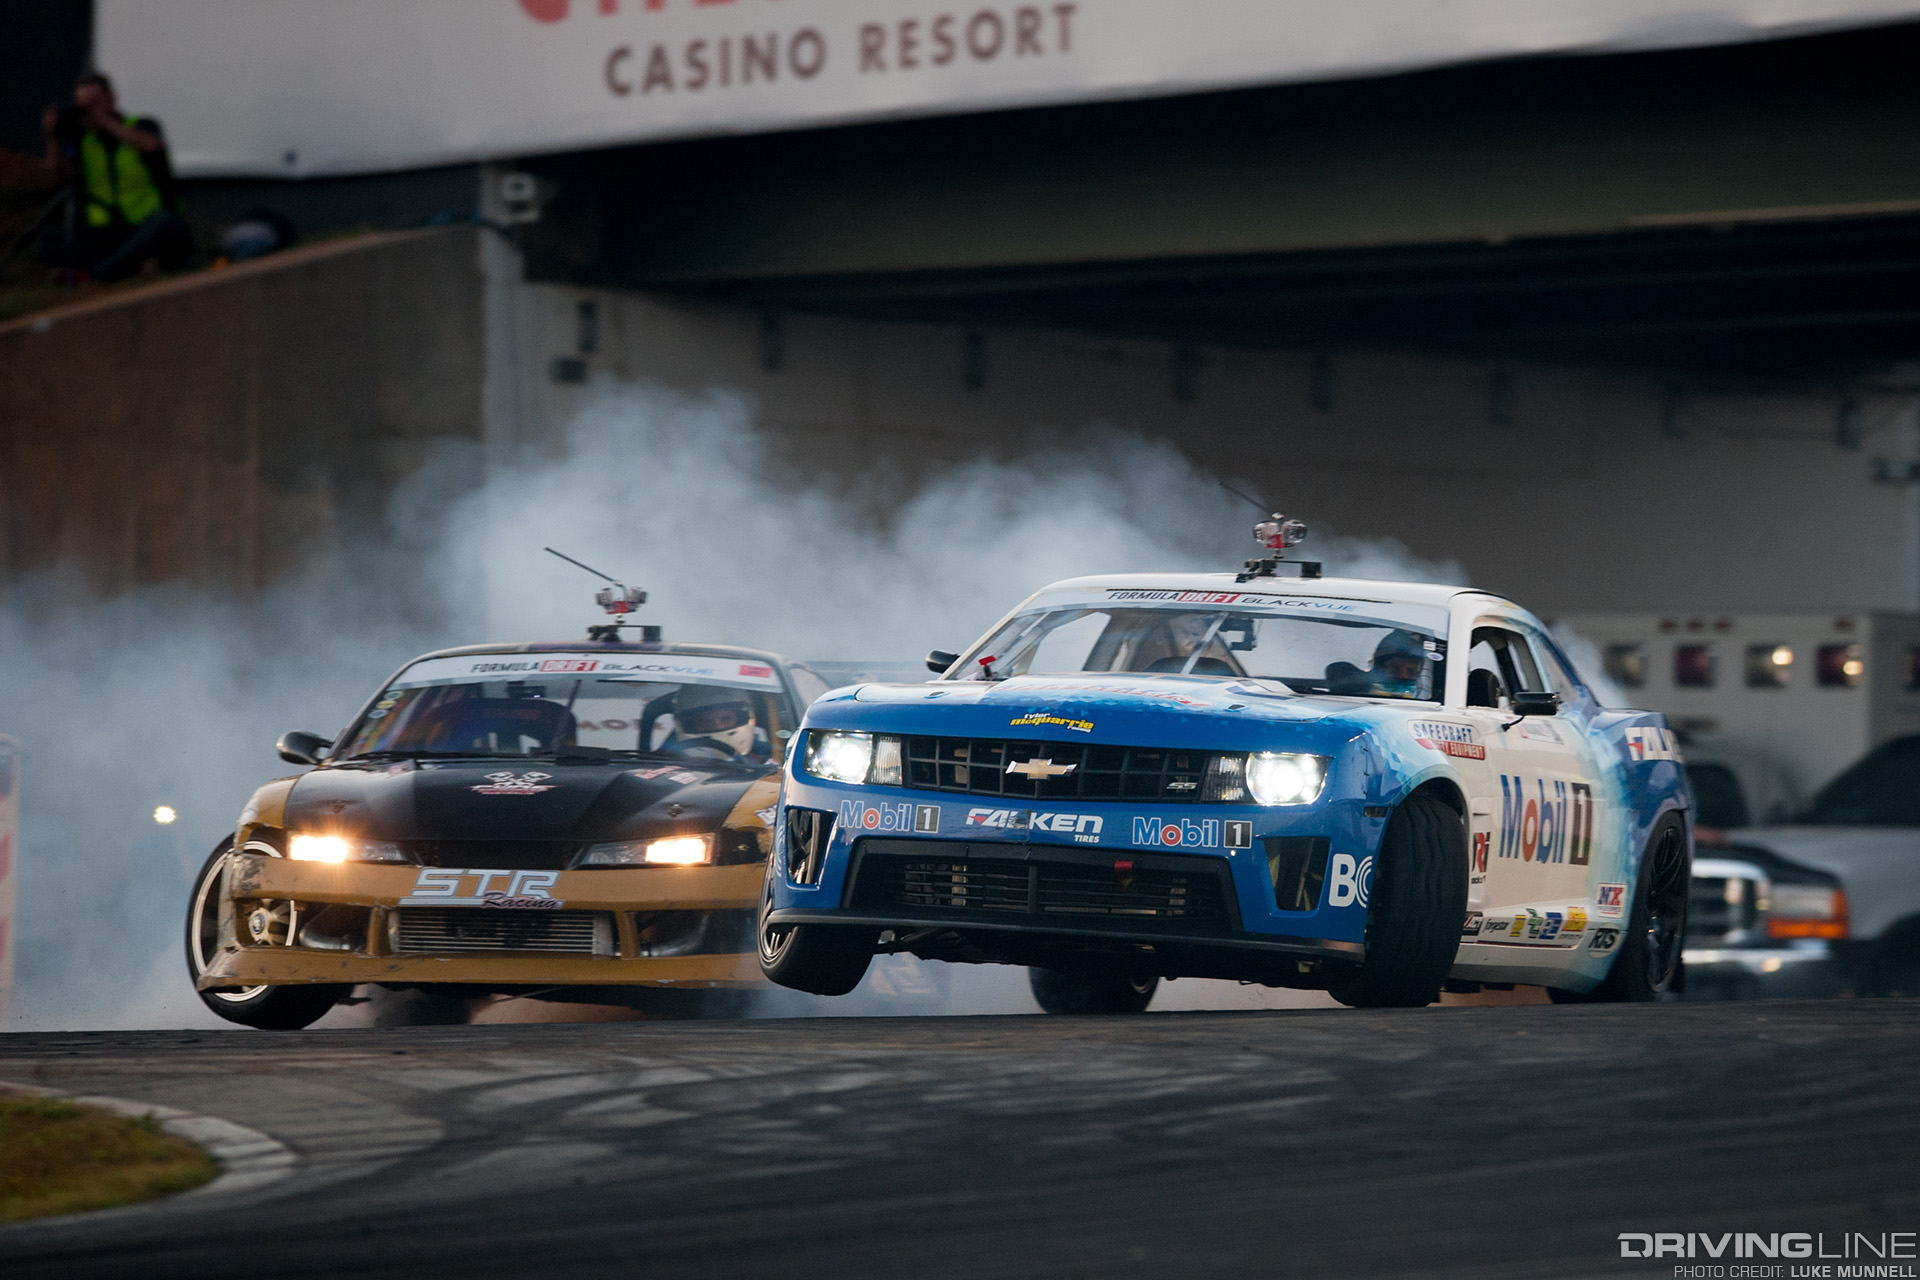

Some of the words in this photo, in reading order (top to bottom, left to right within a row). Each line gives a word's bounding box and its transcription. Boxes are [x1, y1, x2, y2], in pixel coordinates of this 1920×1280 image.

[603, 26, 827, 97] CASINO
[857, 2, 1078, 74] RESORT
[1108, 591, 1178, 601] FORMULA
[1179, 591, 1239, 604] DRIFT
[1242, 597, 1357, 612] BLACKVUE
[470, 662, 540, 674] FORMULA
[541, 660, 600, 673] DRIFT
[602, 663, 715, 675] BLACKVUE
[1067, 725, 1092, 733] racing
[1413, 723, 1473, 744] SAFECRAFT
[1166, 782, 1198, 790] SS
[839, 800, 912, 832] Mobil
[965, 808, 1103, 834] FALKEN
[1500, 774, 1567, 864] Mobil
[1074, 834, 1100, 843] TIRES
[1132, 817, 1219, 847] Mobil
[411, 868, 560, 899] STR
[483, 893, 559, 909] Racing
